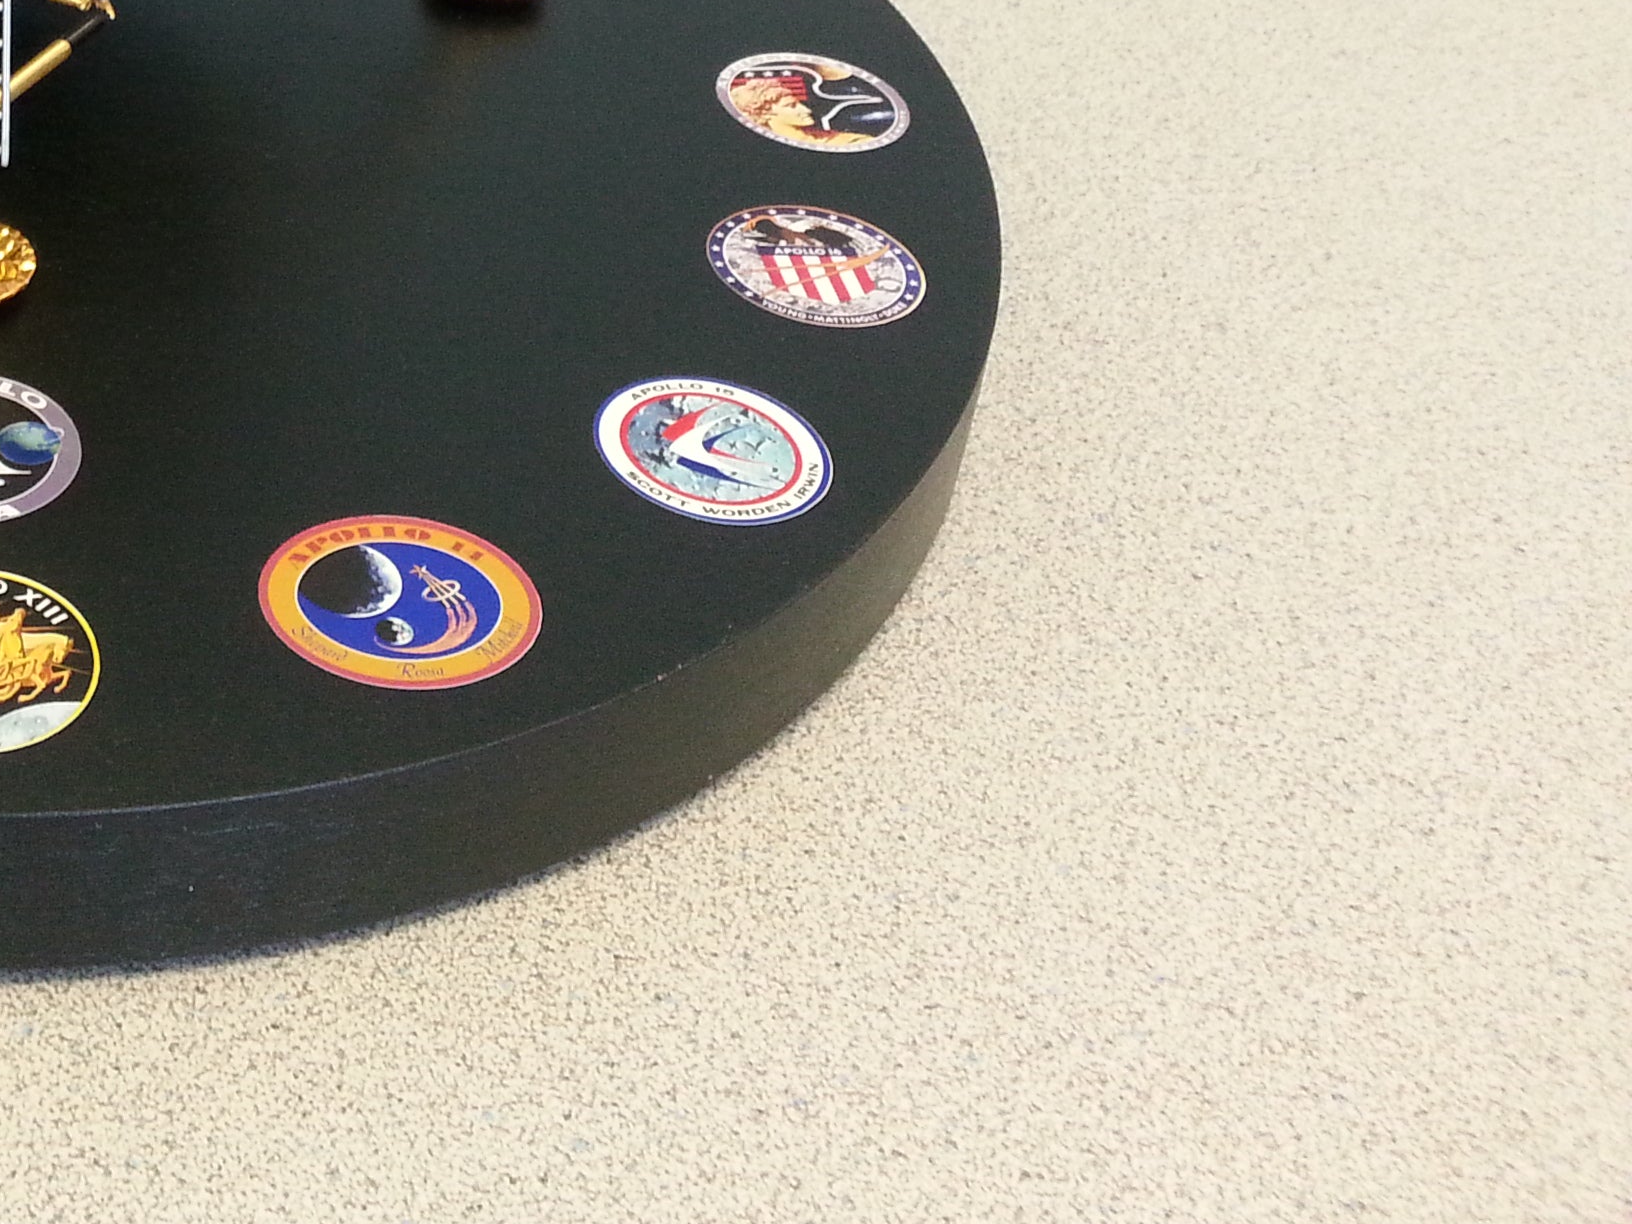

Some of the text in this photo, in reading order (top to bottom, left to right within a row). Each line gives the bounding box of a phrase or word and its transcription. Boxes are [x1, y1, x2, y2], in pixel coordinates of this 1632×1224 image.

[774, 247, 826, 255] APOLLO
[630, 382, 735, 401] APOLLO 15
[626, 462, 819, 517] SCOTT WORDEN IRWIN
[13, 587, 69, 625] XIII
